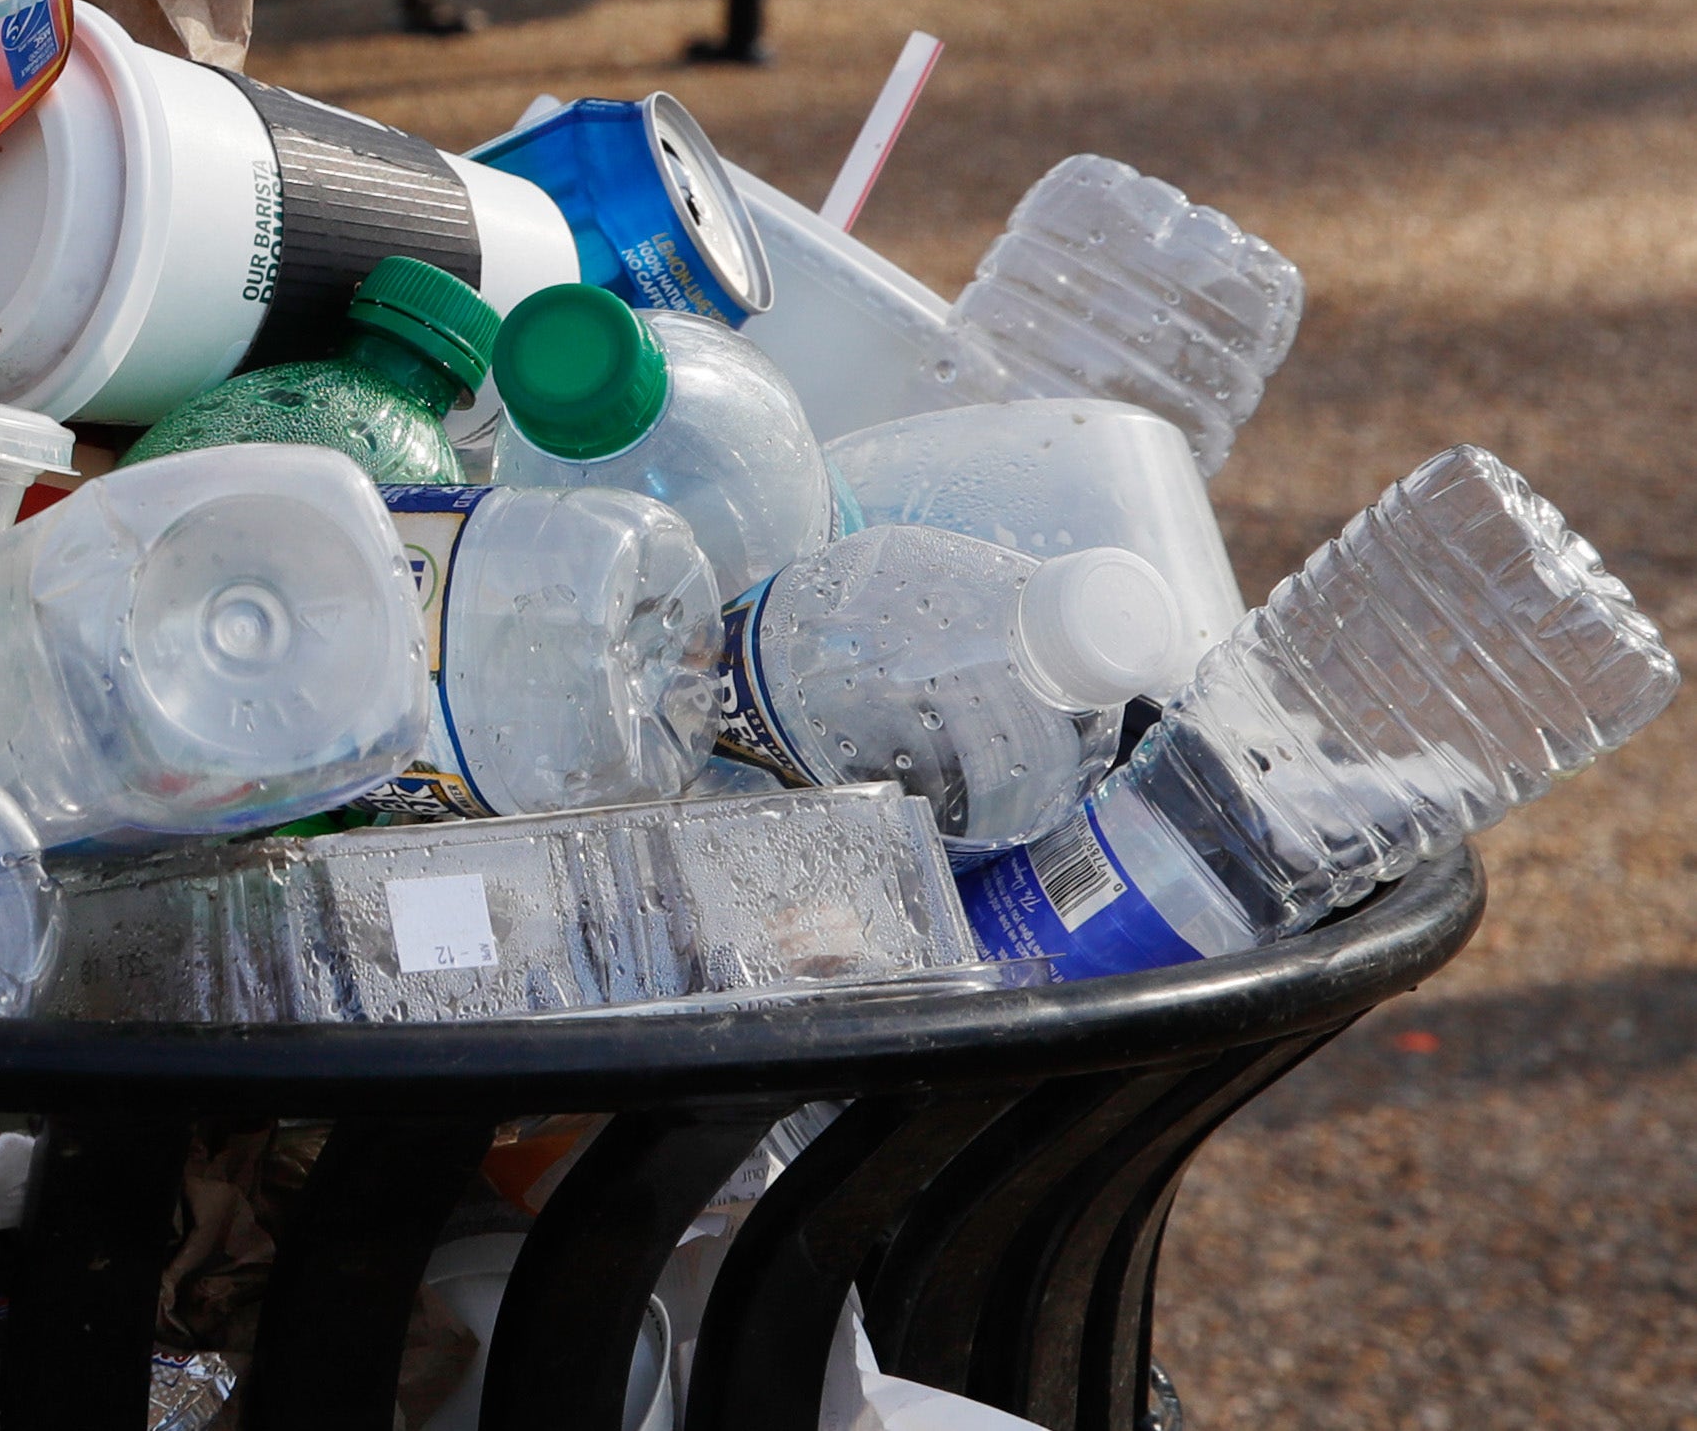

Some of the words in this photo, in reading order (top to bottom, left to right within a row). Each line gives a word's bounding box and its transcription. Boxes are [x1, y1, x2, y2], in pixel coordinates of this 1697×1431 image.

[252, 160, 271, 248] BARISTA
[622, 249, 642, 270] NO
[637, 240, 665, 276] 100%
[242, 254, 268, 300] OUR
[435, 945, 455, 965] 12
